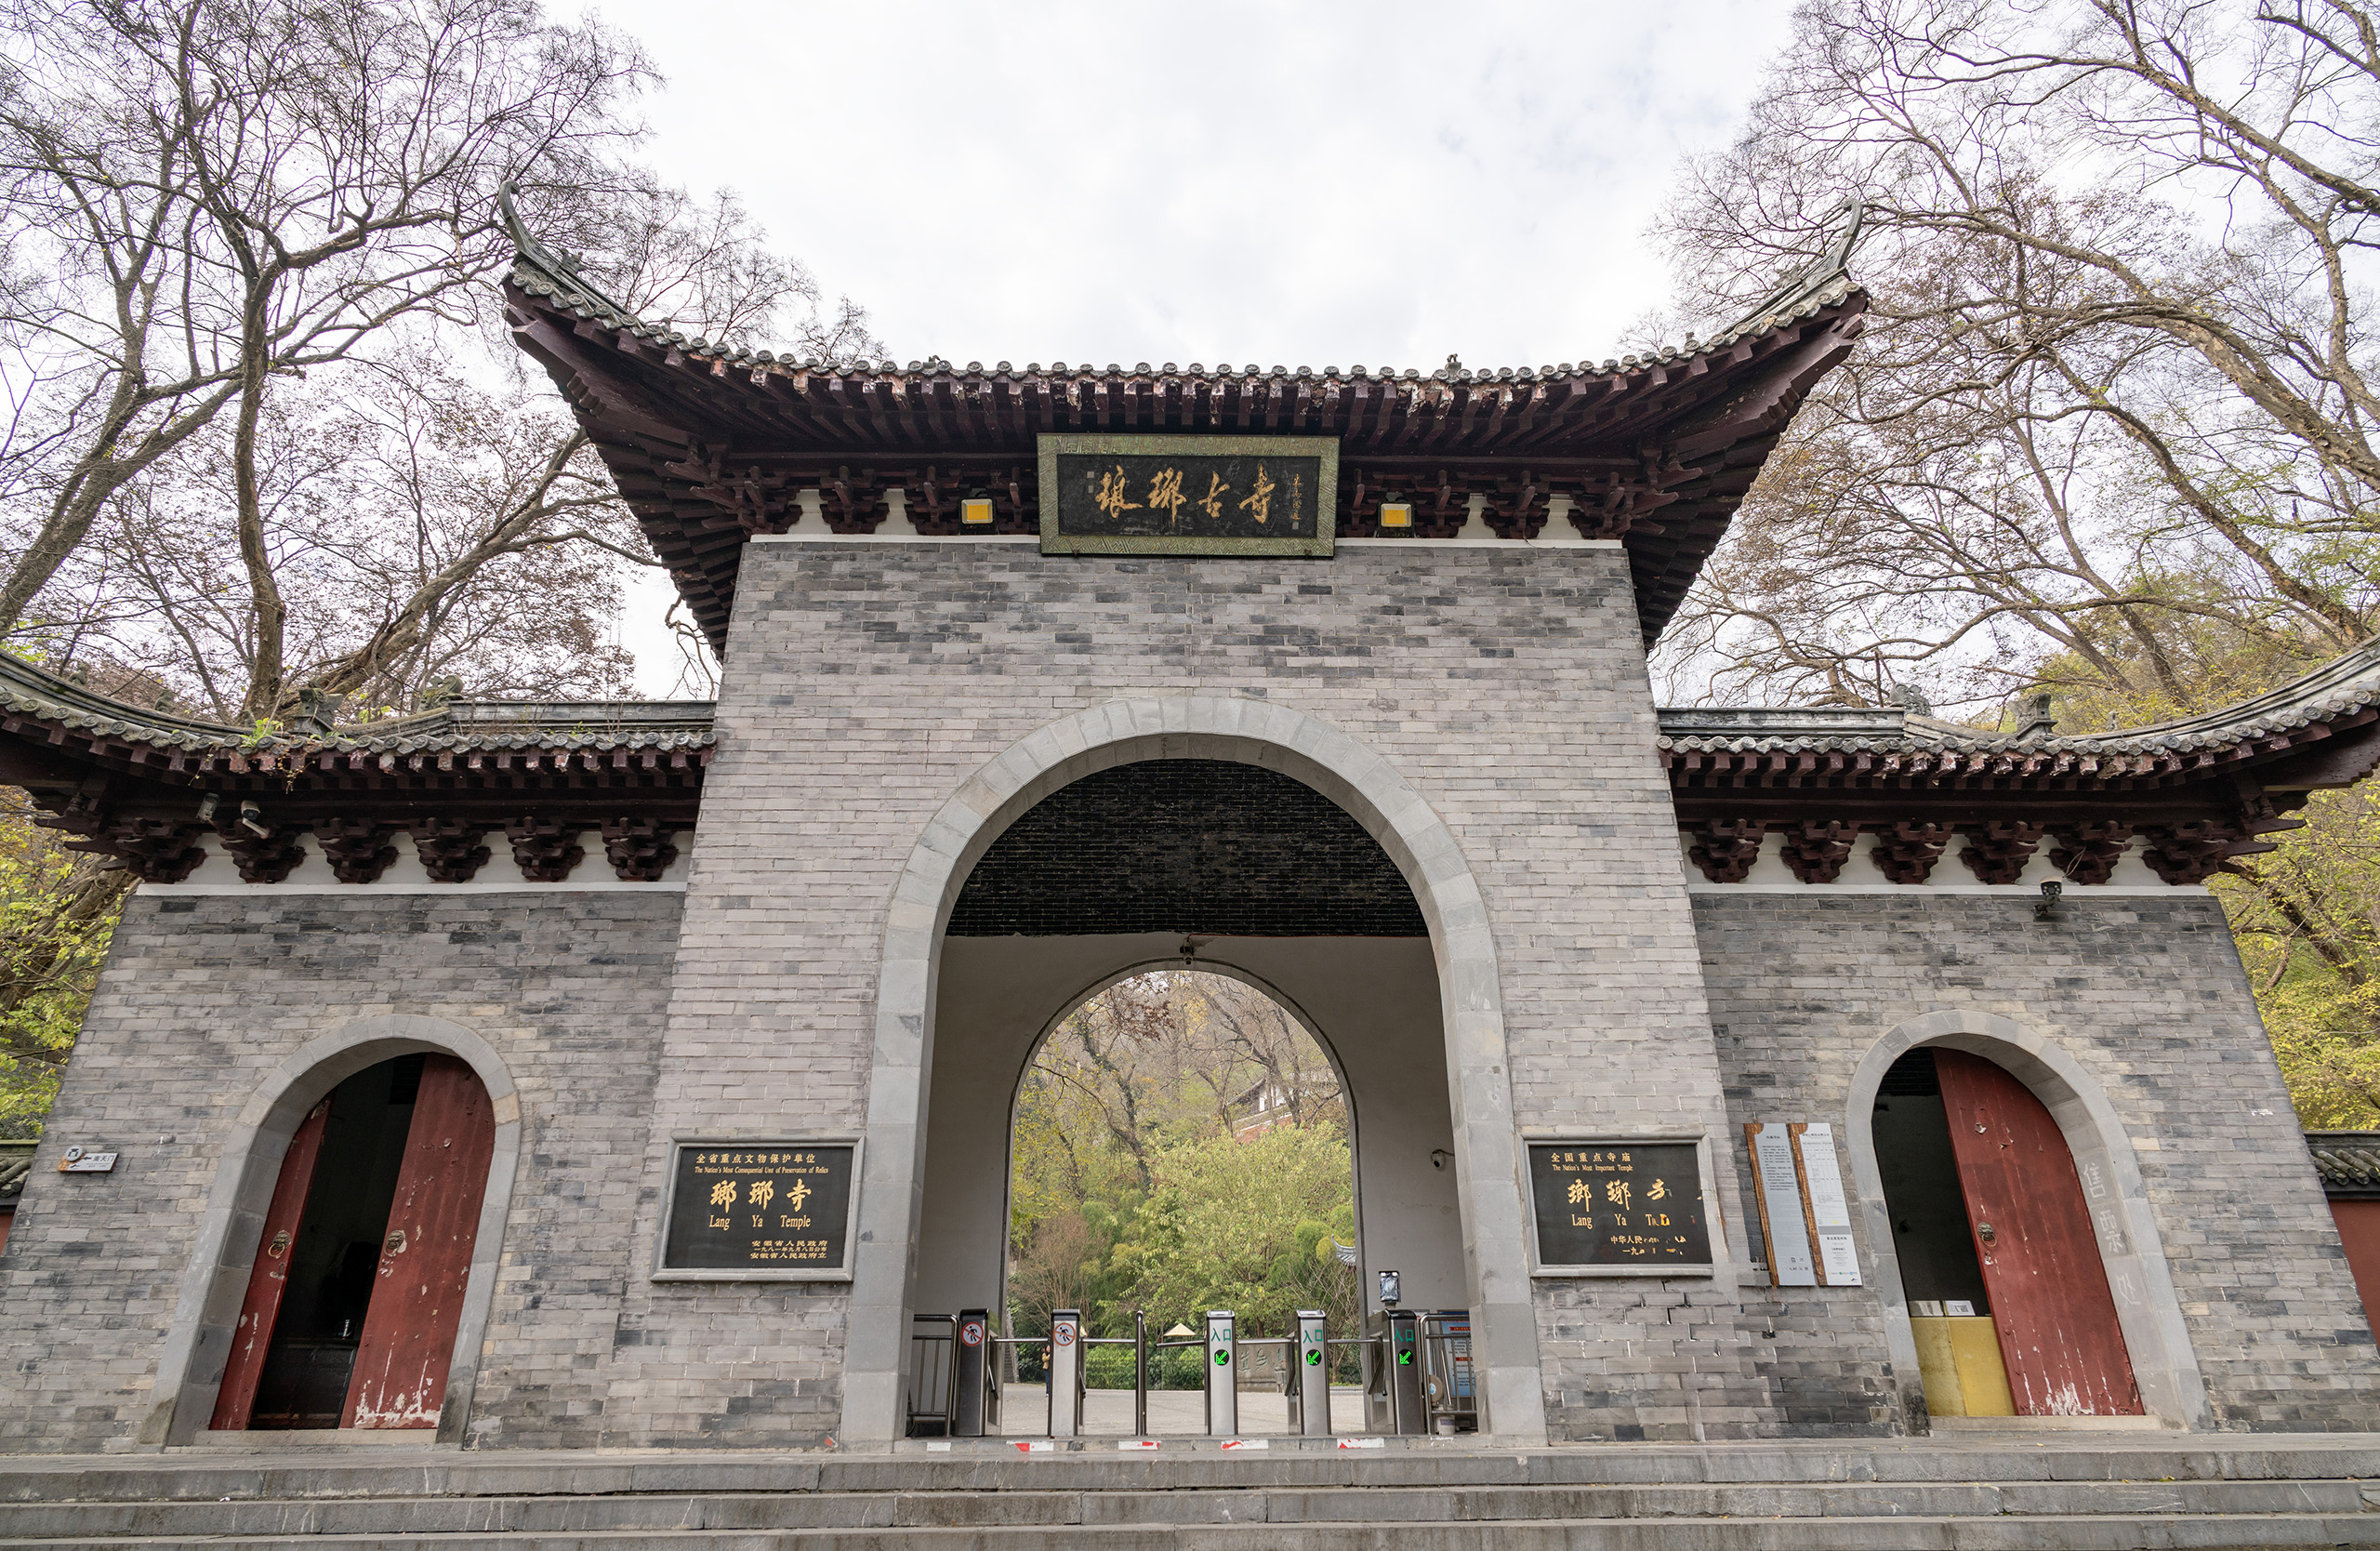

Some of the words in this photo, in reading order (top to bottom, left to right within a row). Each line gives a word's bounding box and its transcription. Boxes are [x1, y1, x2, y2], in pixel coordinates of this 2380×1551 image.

[695, 1152, 816, 1164] 全省重点文物保护单位
[1550, 1152, 1632, 1162] 全国重点寺庙
[775, 1166, 782, 1174] of
[809, 1166, 814, 1174] of
[815, 1166, 829, 1174] Relics
[1595, 1163, 1615, 1173] Important
[1618, 1164, 1633, 1173] Temple
[709, 1214, 731, 1231] Lang
[751, 1214, 763, 1228] Ya
[780, 1214, 812, 1230] Temple
[1571, 1213, 1593, 1229] Lang
[1614, 1213, 1628, 1226] Ya
[1211, 1328, 1232, 1342] 入口
[1302, 1329, 1323, 1344] 入口
[1394, 1328, 1414, 1343] 入口
